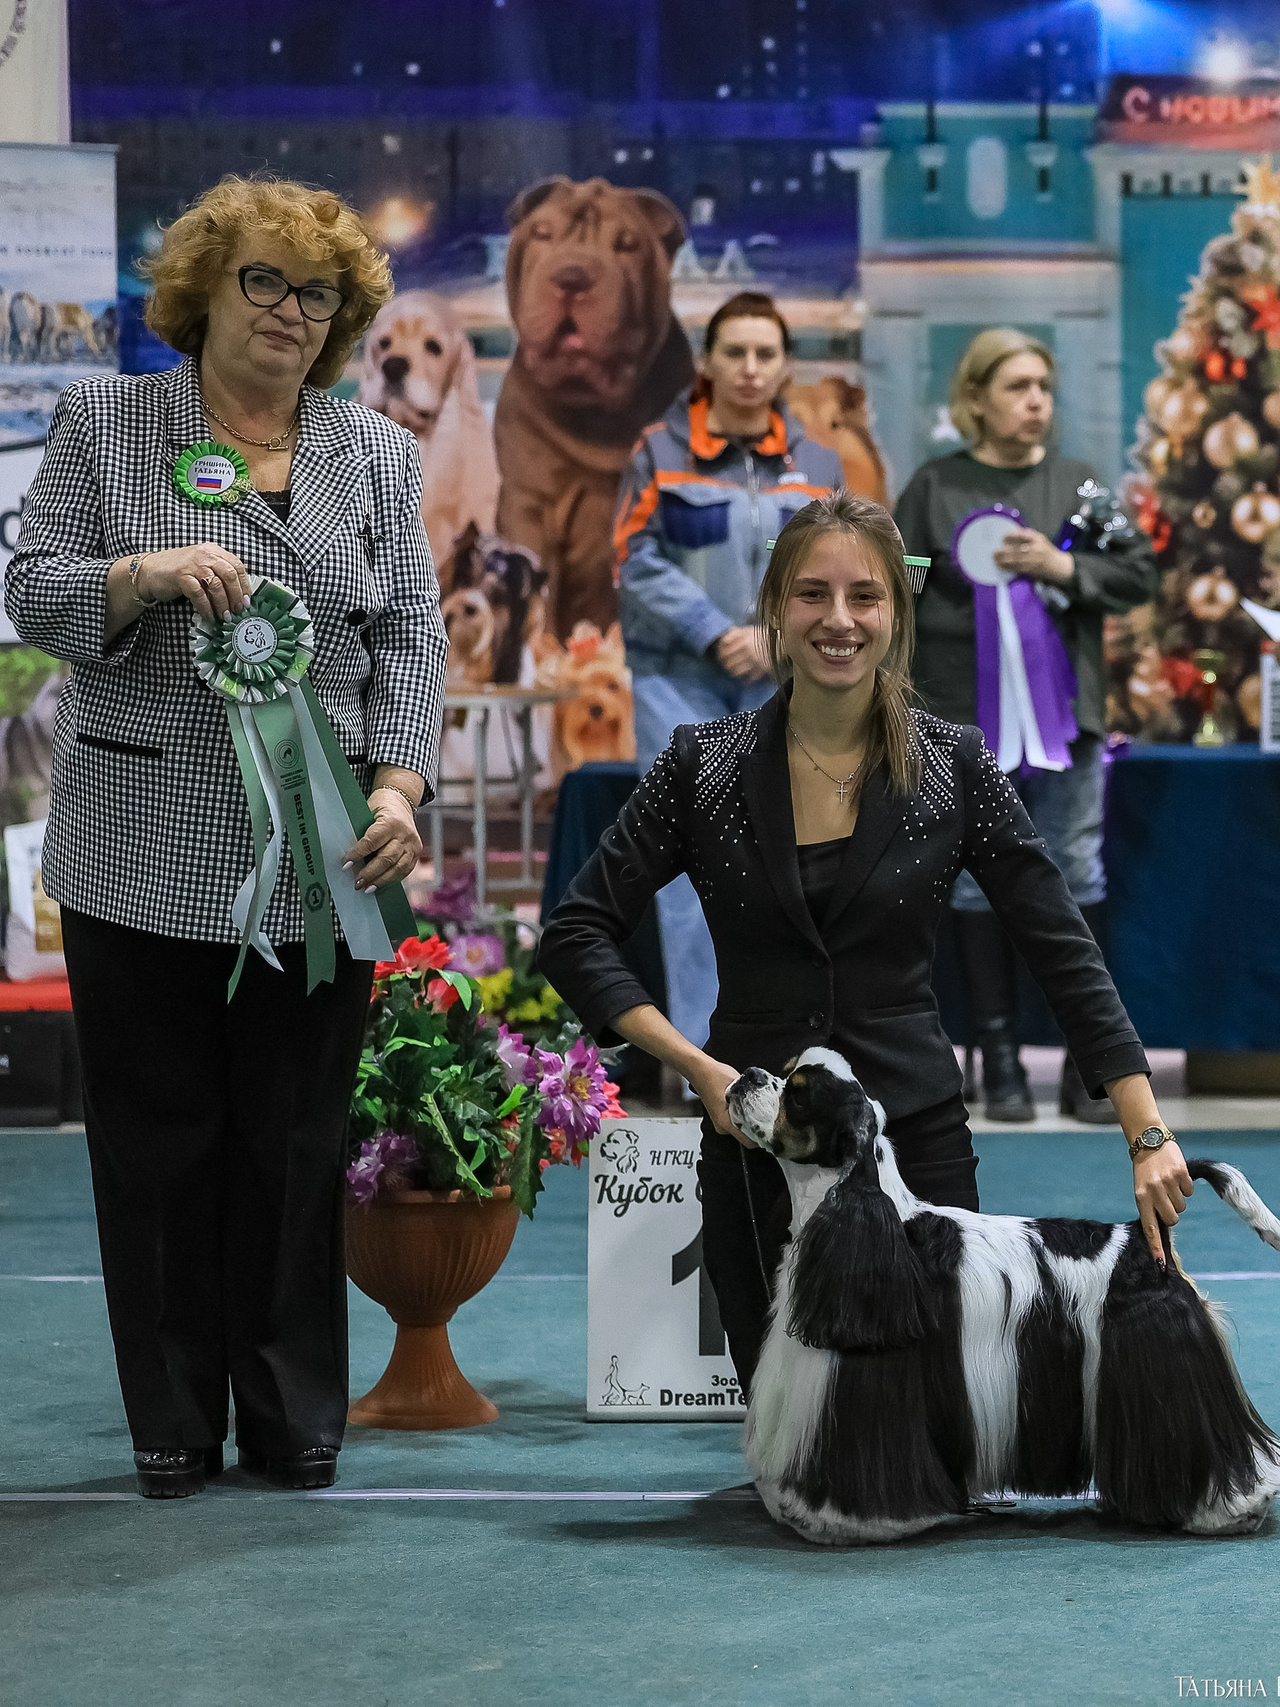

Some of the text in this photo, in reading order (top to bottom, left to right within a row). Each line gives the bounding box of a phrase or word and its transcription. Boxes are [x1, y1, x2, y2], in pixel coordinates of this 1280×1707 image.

[194, 460, 232, 469] ГРИШИНА
[194, 467, 231, 476] ТАТЬЯНА
[293, 793, 305, 821] BEST
[299, 823, 308, 836] IN
[301, 836, 315, 876] GROUP
[311, 890, 320, 904] 1
[650, 1150, 694, 1169] НГКЦ
[594, 1174, 684, 1218] Кубок
